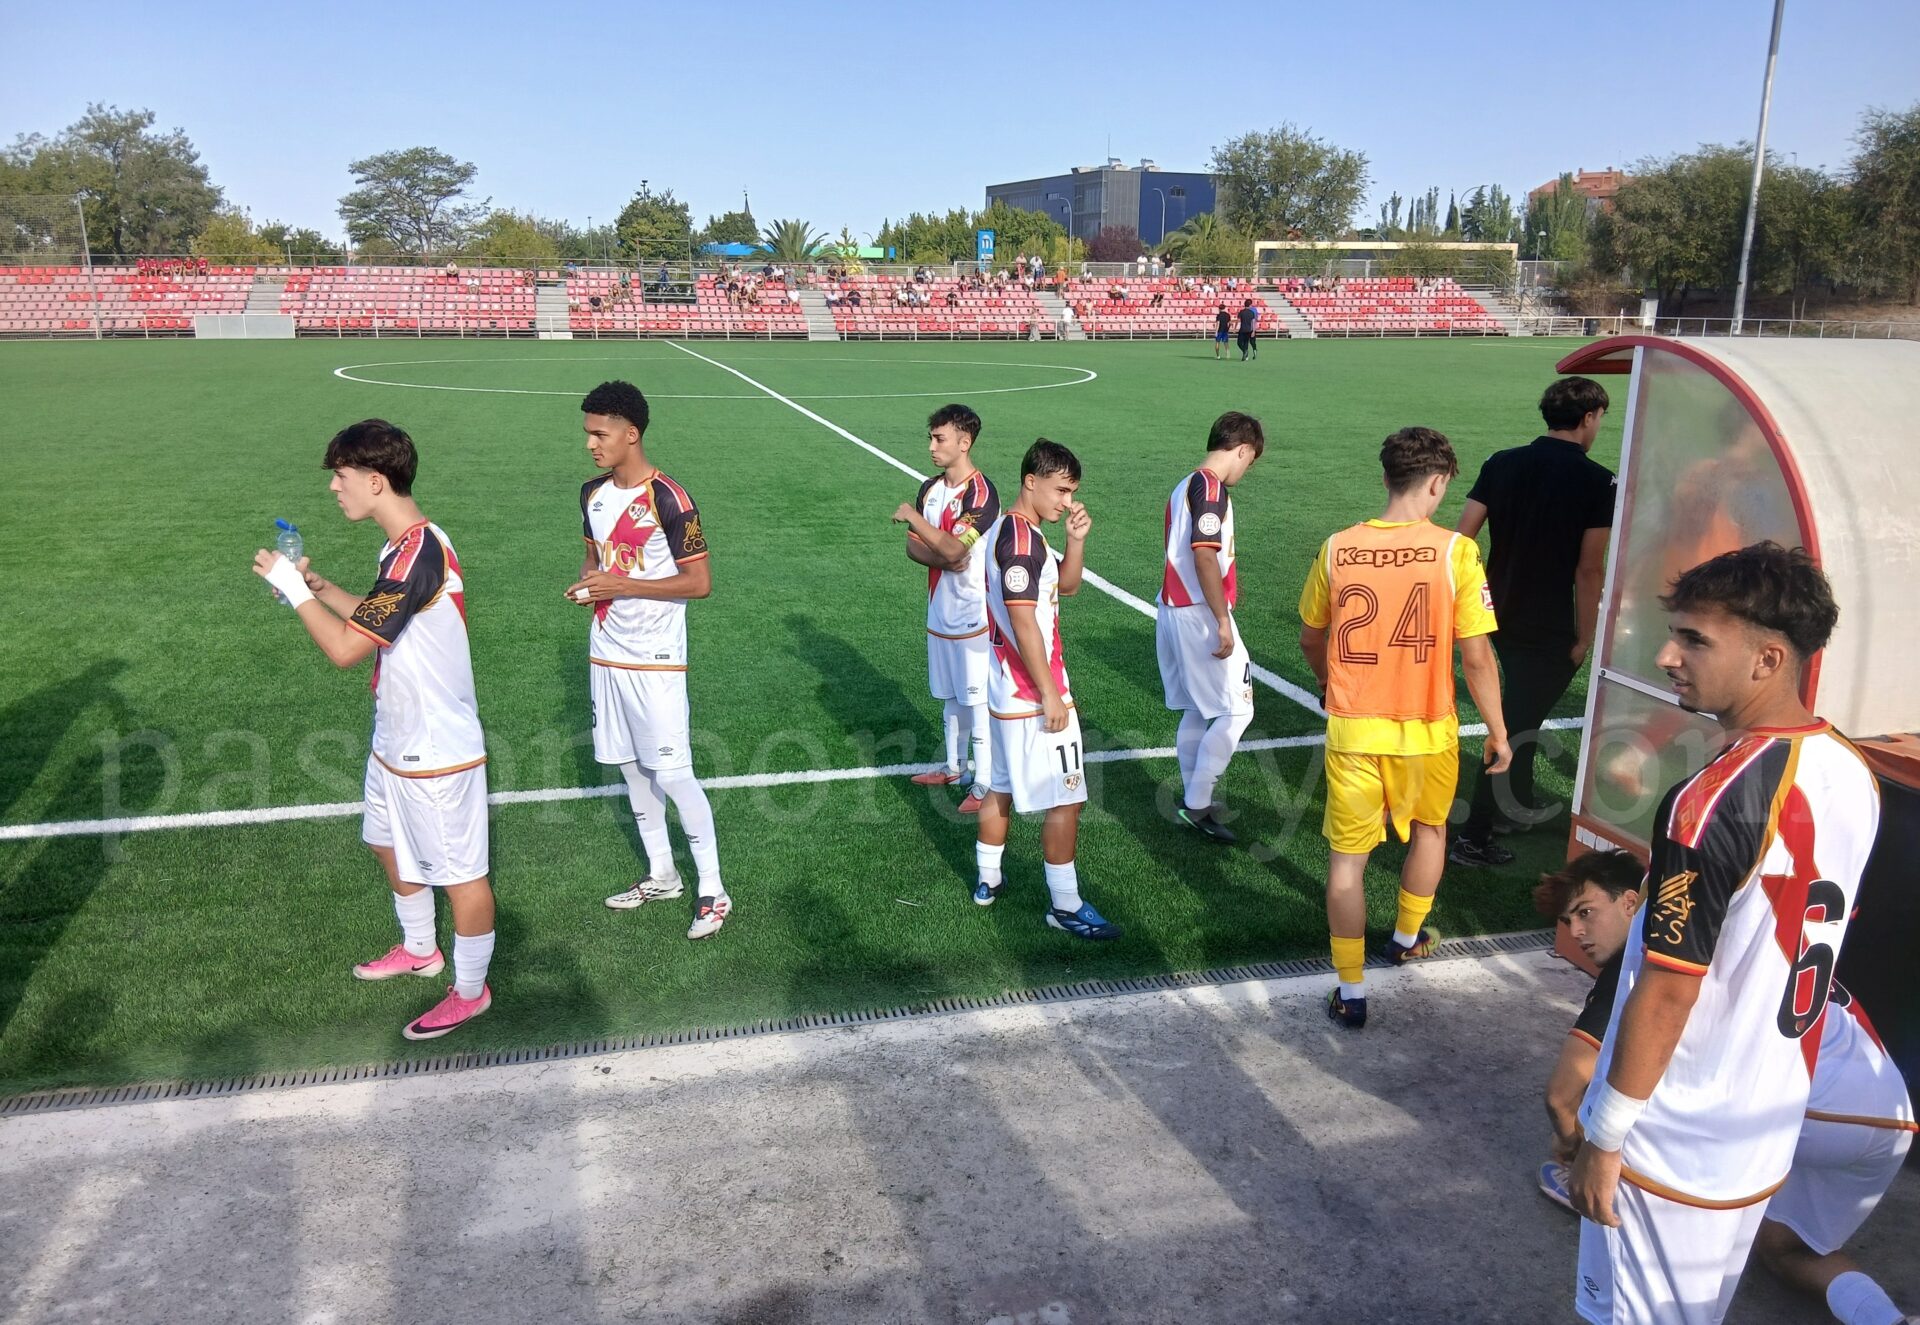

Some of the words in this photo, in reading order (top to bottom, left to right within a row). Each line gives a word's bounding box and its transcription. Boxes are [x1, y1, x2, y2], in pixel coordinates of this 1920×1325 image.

[1337, 547, 1437, 568] Kappa
[1337, 582, 1437, 665] 24
[1055, 741, 1080, 774] 11
[1776, 879, 1846, 1039] 6
